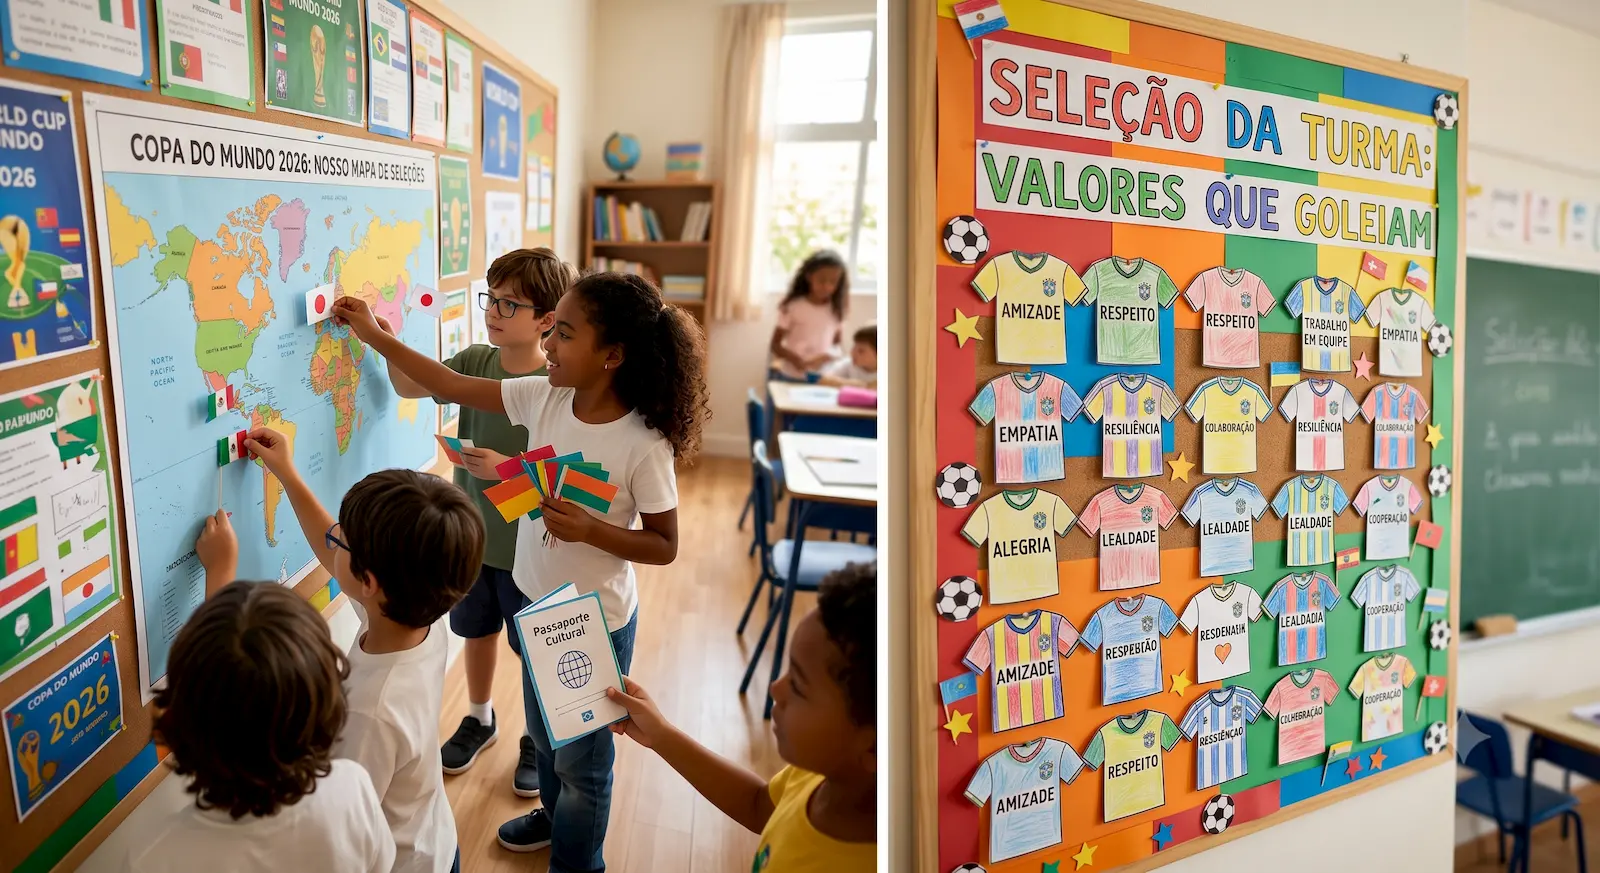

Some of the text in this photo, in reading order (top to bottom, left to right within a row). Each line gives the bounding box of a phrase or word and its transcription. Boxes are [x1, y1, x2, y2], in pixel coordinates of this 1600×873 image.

[322, 5, 340, 26] 2026
[32, 109, 66, 131] CUP
[990, 58, 1431, 178] SELEÇÃO DA TURMA:
[0, 128, 43, 151] NDO
[130, 133, 185, 164] COPA
[191, 140, 215, 167] DO
[220, 143, 275, 171] MUNDO
[279, 150, 311, 174] 2026:
[314, 155, 349, 177] NOSSO
[351, 160, 376, 180] MAPA
[378, 163, 389, 180] DE
[390, 163, 425, 185] SELEÇÕES
[982, 153, 1186, 221] VALORES
[1205, 181, 1280, 231] QUE
[1294, 193, 1432, 250] GOLEIAM
[1001, 303, 1061, 321] AMIZADE
[1100, 306, 1155, 322] RESPEITO
[1206, 313, 1255, 329] RESPEITO
[1304, 317, 1348, 332] TRABALHO
[1304, 334, 1348, 348] EM EQUIPE
[1382, 327, 1418, 343] EMPATIA
[151, 356, 173, 365] NORTH
[150, 365, 175, 376] PACIFIC
[154, 376, 174, 387] OCEAN
[1000, 425, 1058, 443] EMPATIA
[1105, 420, 1160, 435] RESILIÊNCIA
[1205, 420, 1255, 435] COLABORAÇÃO
[1298, 420, 1342, 433] RESILIÊNCIA
[1290, 515, 1332, 530] LEALDADE
[1369, 513, 1408, 525] COOPERAÇÃO
[1203, 520, 1250, 536] LEALDADE
[993, 536, 1051, 558] ALEGRIA
[1103, 530, 1156, 547] LEALDADE
[1367, 602, 1405, 616] COOPERAÇÃO
[533, 612, 590, 637] Passaporte
[1281, 611, 1323, 628] LEALDADIA
[545, 626, 586, 646] Cultural
[28, 651, 99, 711] COPA DO MUNDO
[996, 660, 1055, 685] AMIZADE
[1365, 688, 1402, 706] COOPERAÇÃO
[49, 674, 110, 745] 2026
[1108, 754, 1158, 780] RESPEITO
[996, 786, 1055, 815] AMIZADE
